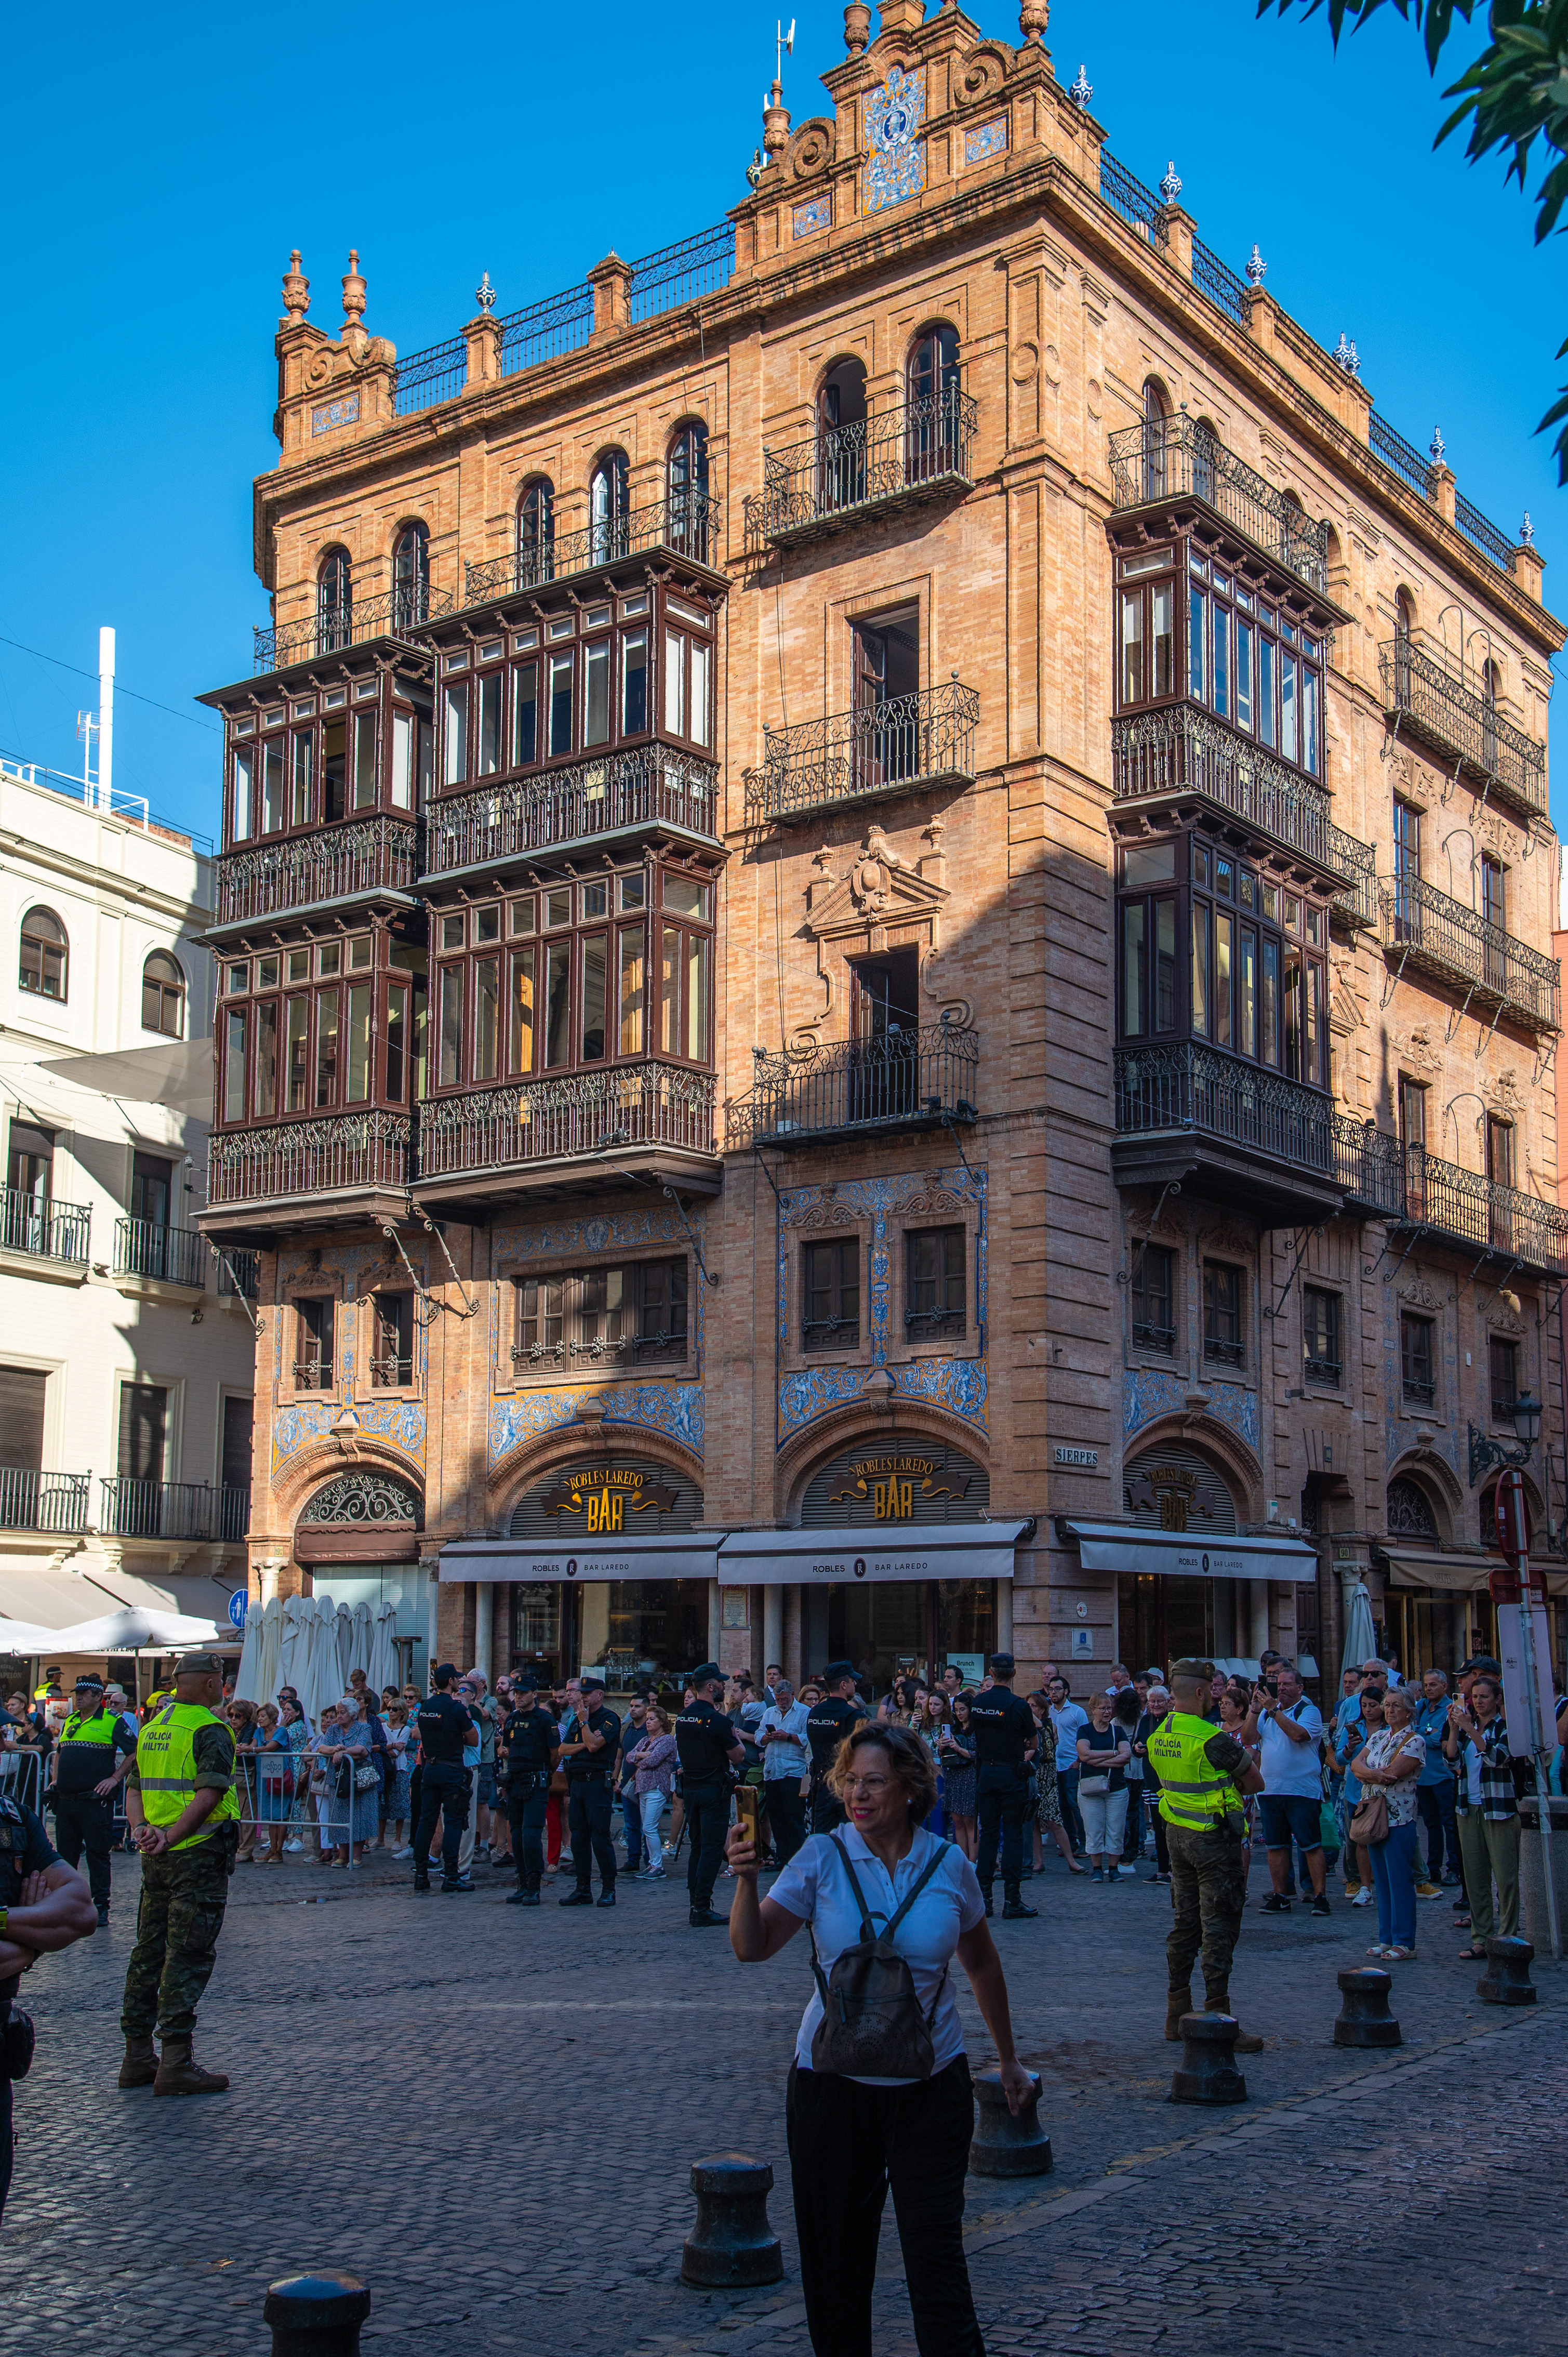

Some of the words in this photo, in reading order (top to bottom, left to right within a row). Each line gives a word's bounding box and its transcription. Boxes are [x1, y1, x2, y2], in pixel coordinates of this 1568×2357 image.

[1056, 1448, 1098, 1465] SIERPES
[855, 1457, 892, 1477] ROBLES
[893, 1457, 933, 1475] LAREDO
[569, 1470, 604, 1490] ROBLES
[605, 1470, 643, 1488] LAREDO
[874, 1475, 912, 1518] BAR
[588, 1488, 623, 1531] BAR
[145, 1730, 171, 1740] POLICÍA
[1154, 1738, 1181, 1748] POLICÍA
[142, 1742, 170, 1751] MILITAR
[1154, 1747, 1182, 1758] MILITAR
